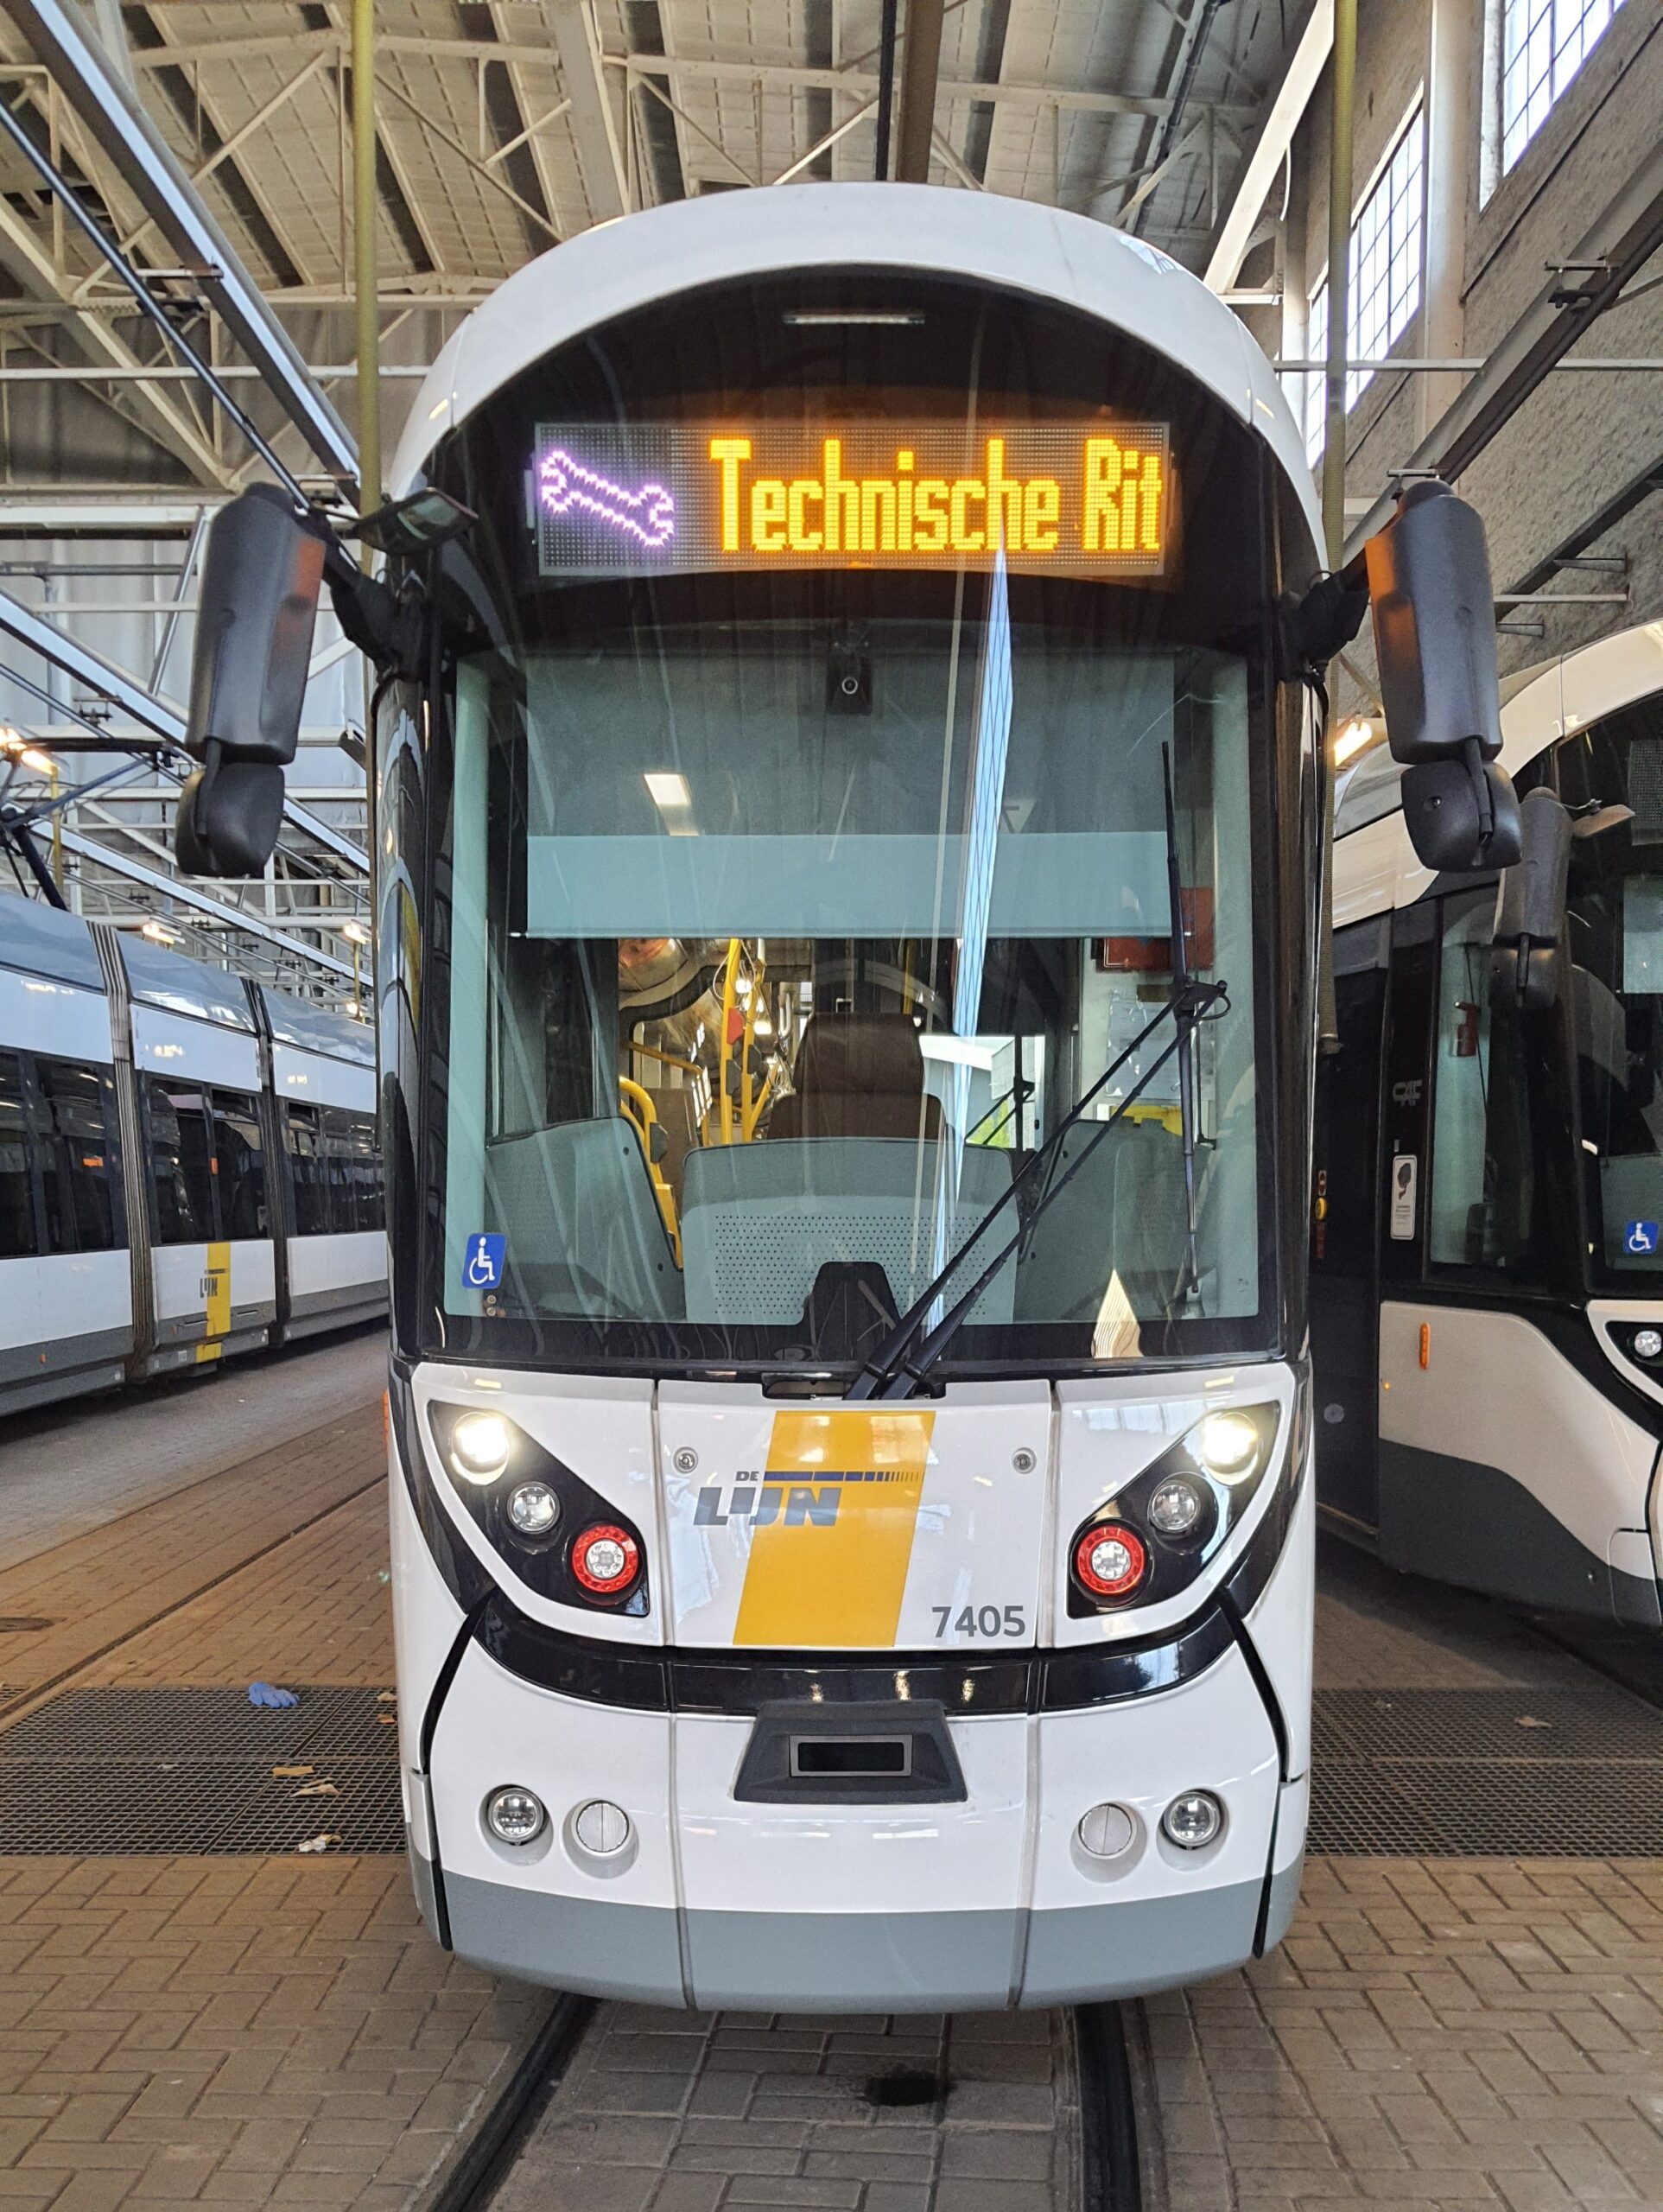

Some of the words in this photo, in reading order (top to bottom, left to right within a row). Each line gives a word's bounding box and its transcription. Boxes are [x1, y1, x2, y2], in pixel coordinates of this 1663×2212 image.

[709, 438, 1060, 552] Technische
[1082, 438, 1163, 551] Rit
[735, 1471, 760, 1482] DE
[693, 1486, 842, 1527] LIJN
[931, 1605, 1026, 1638] 7405
